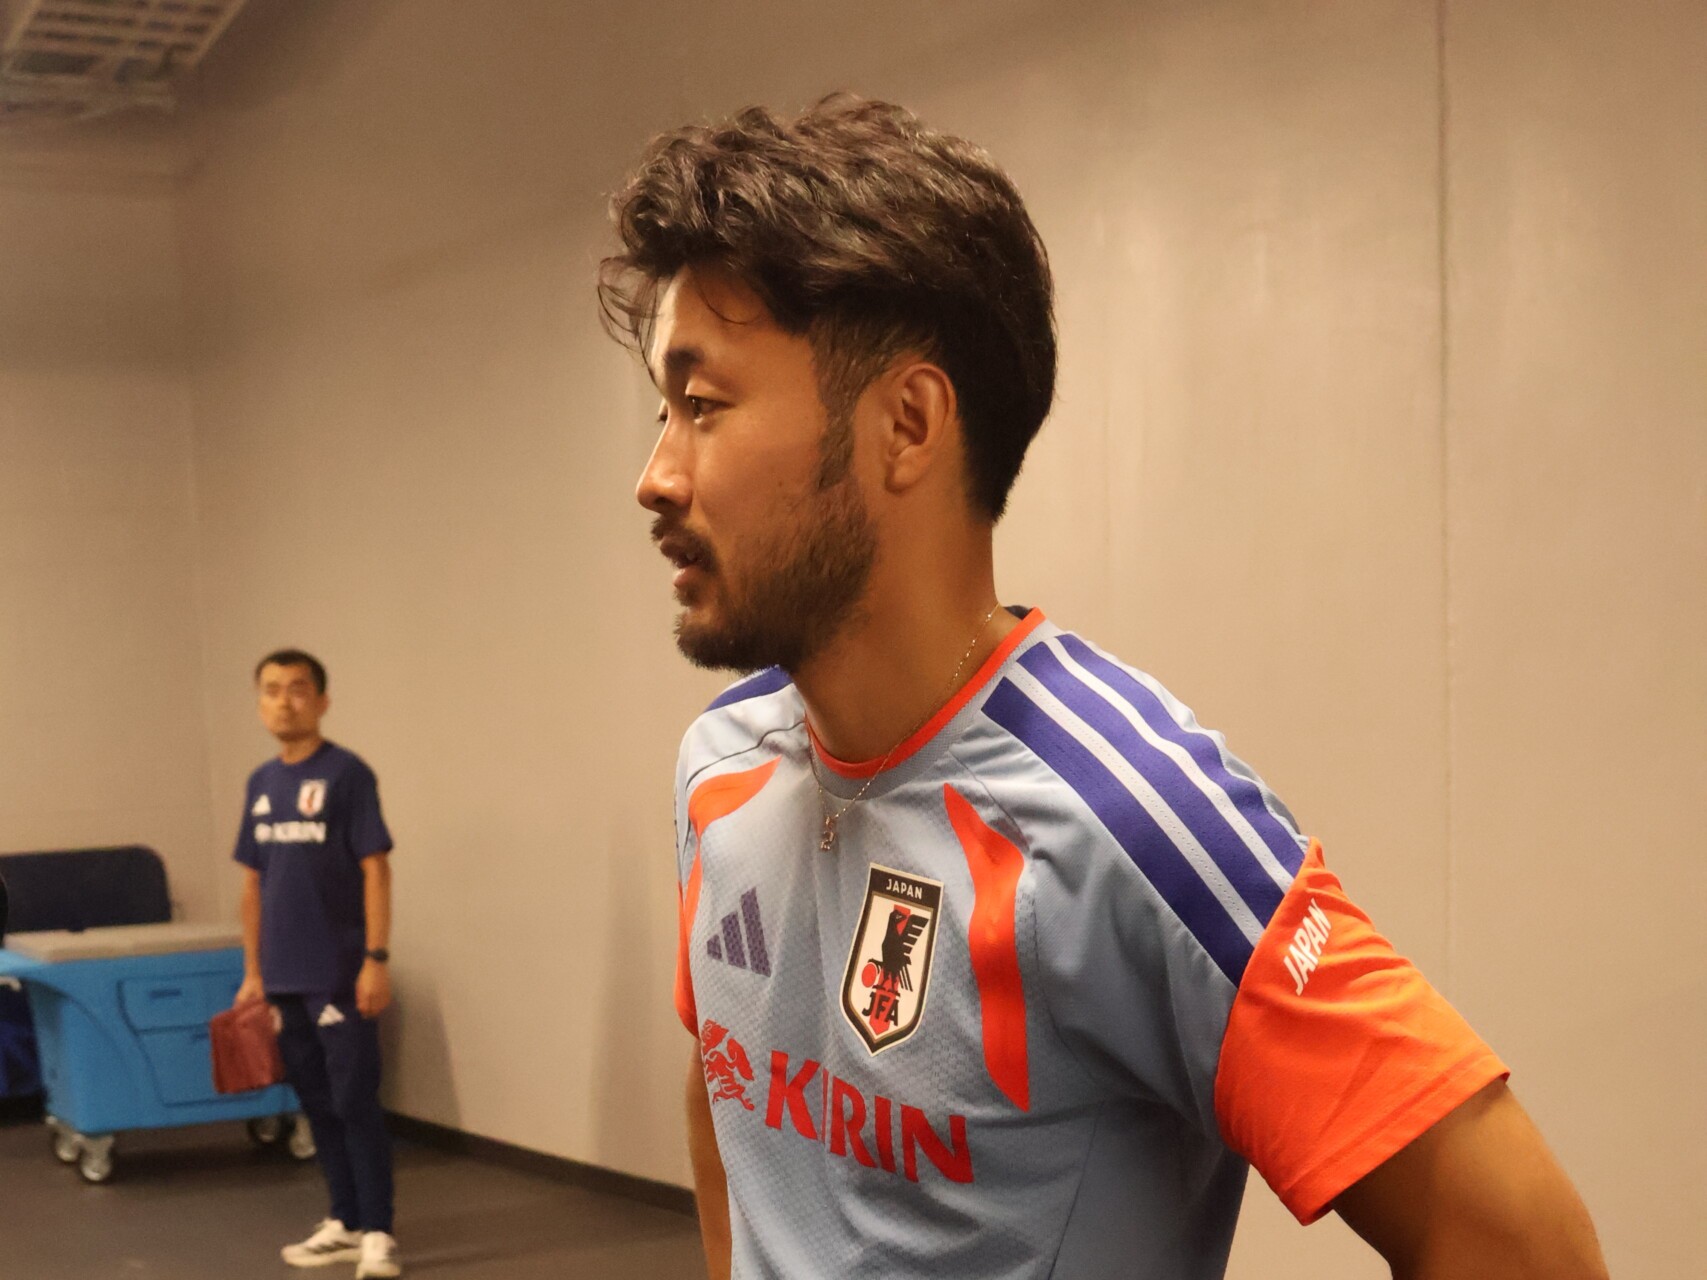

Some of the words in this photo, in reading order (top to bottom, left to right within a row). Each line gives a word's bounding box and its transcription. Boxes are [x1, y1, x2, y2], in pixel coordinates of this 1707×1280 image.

[886, 878, 923, 900] JAPAN
[1283, 897, 1332, 996] JAPAN
[861, 991, 900, 1027] JFA
